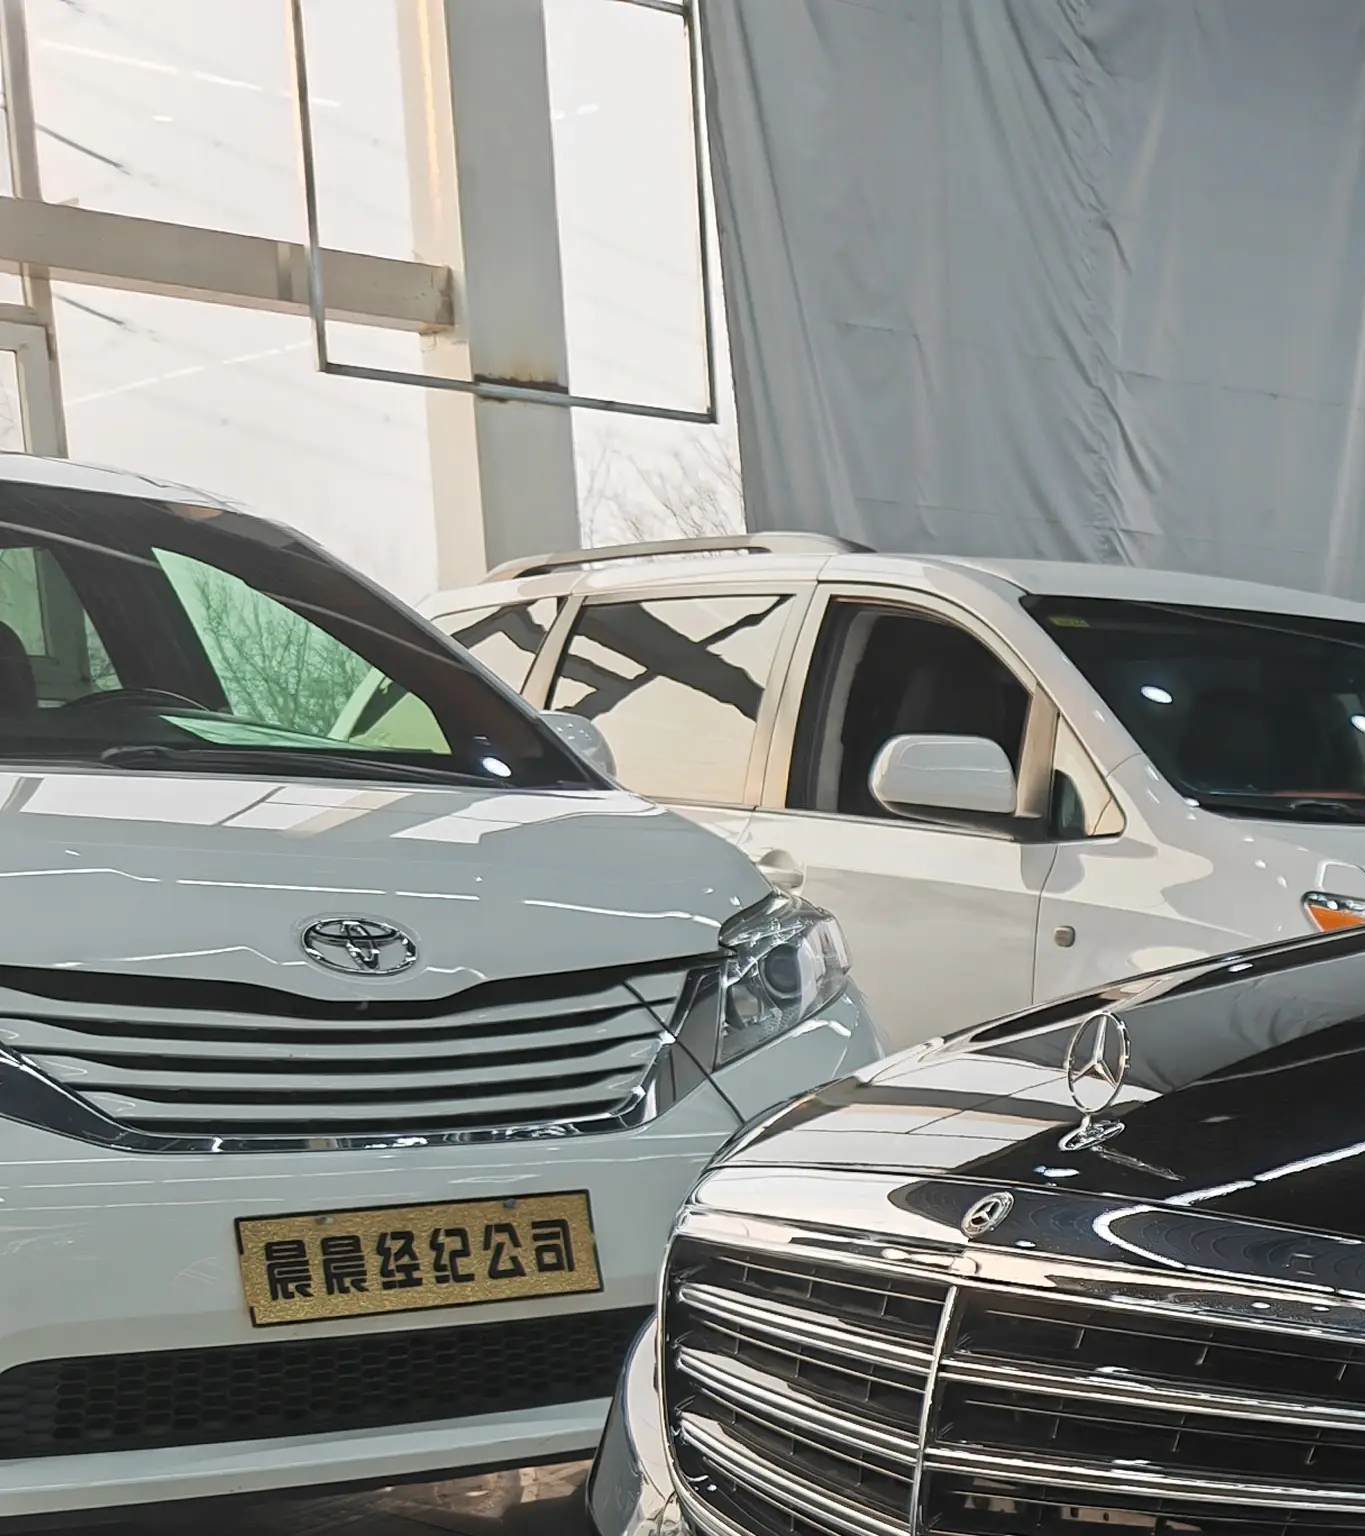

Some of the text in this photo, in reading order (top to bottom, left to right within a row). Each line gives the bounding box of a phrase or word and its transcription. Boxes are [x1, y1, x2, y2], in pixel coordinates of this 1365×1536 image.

[264, 1218, 575, 1300] 晨晨经纪公司
